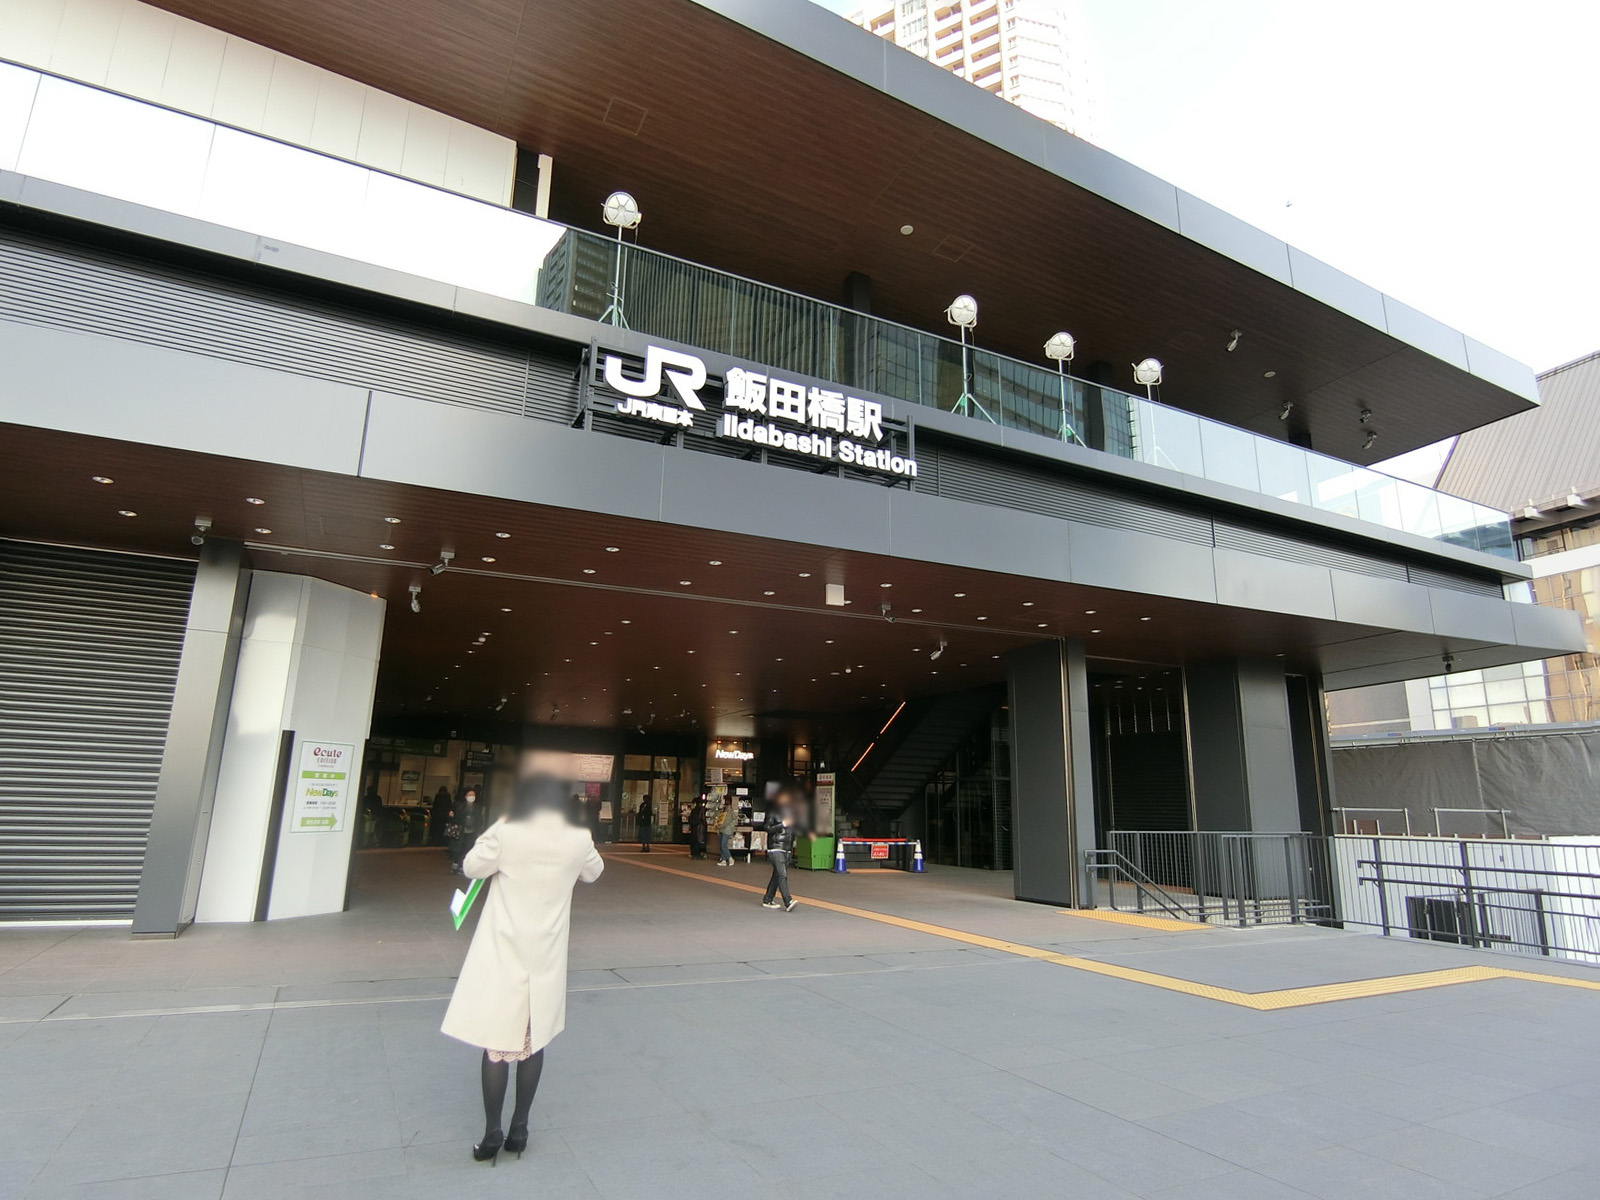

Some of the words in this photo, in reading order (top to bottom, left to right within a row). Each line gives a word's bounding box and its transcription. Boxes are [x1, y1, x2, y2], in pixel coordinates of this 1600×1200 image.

[604, 345, 707, 411] JR
[724, 367, 884, 442] 飯田橋駅
[722, 414, 832, 459] Iidabashi
[837, 439, 918, 478] Station
[715, 749, 754, 761] NewDays
[305, 787, 339, 798] NewDays
